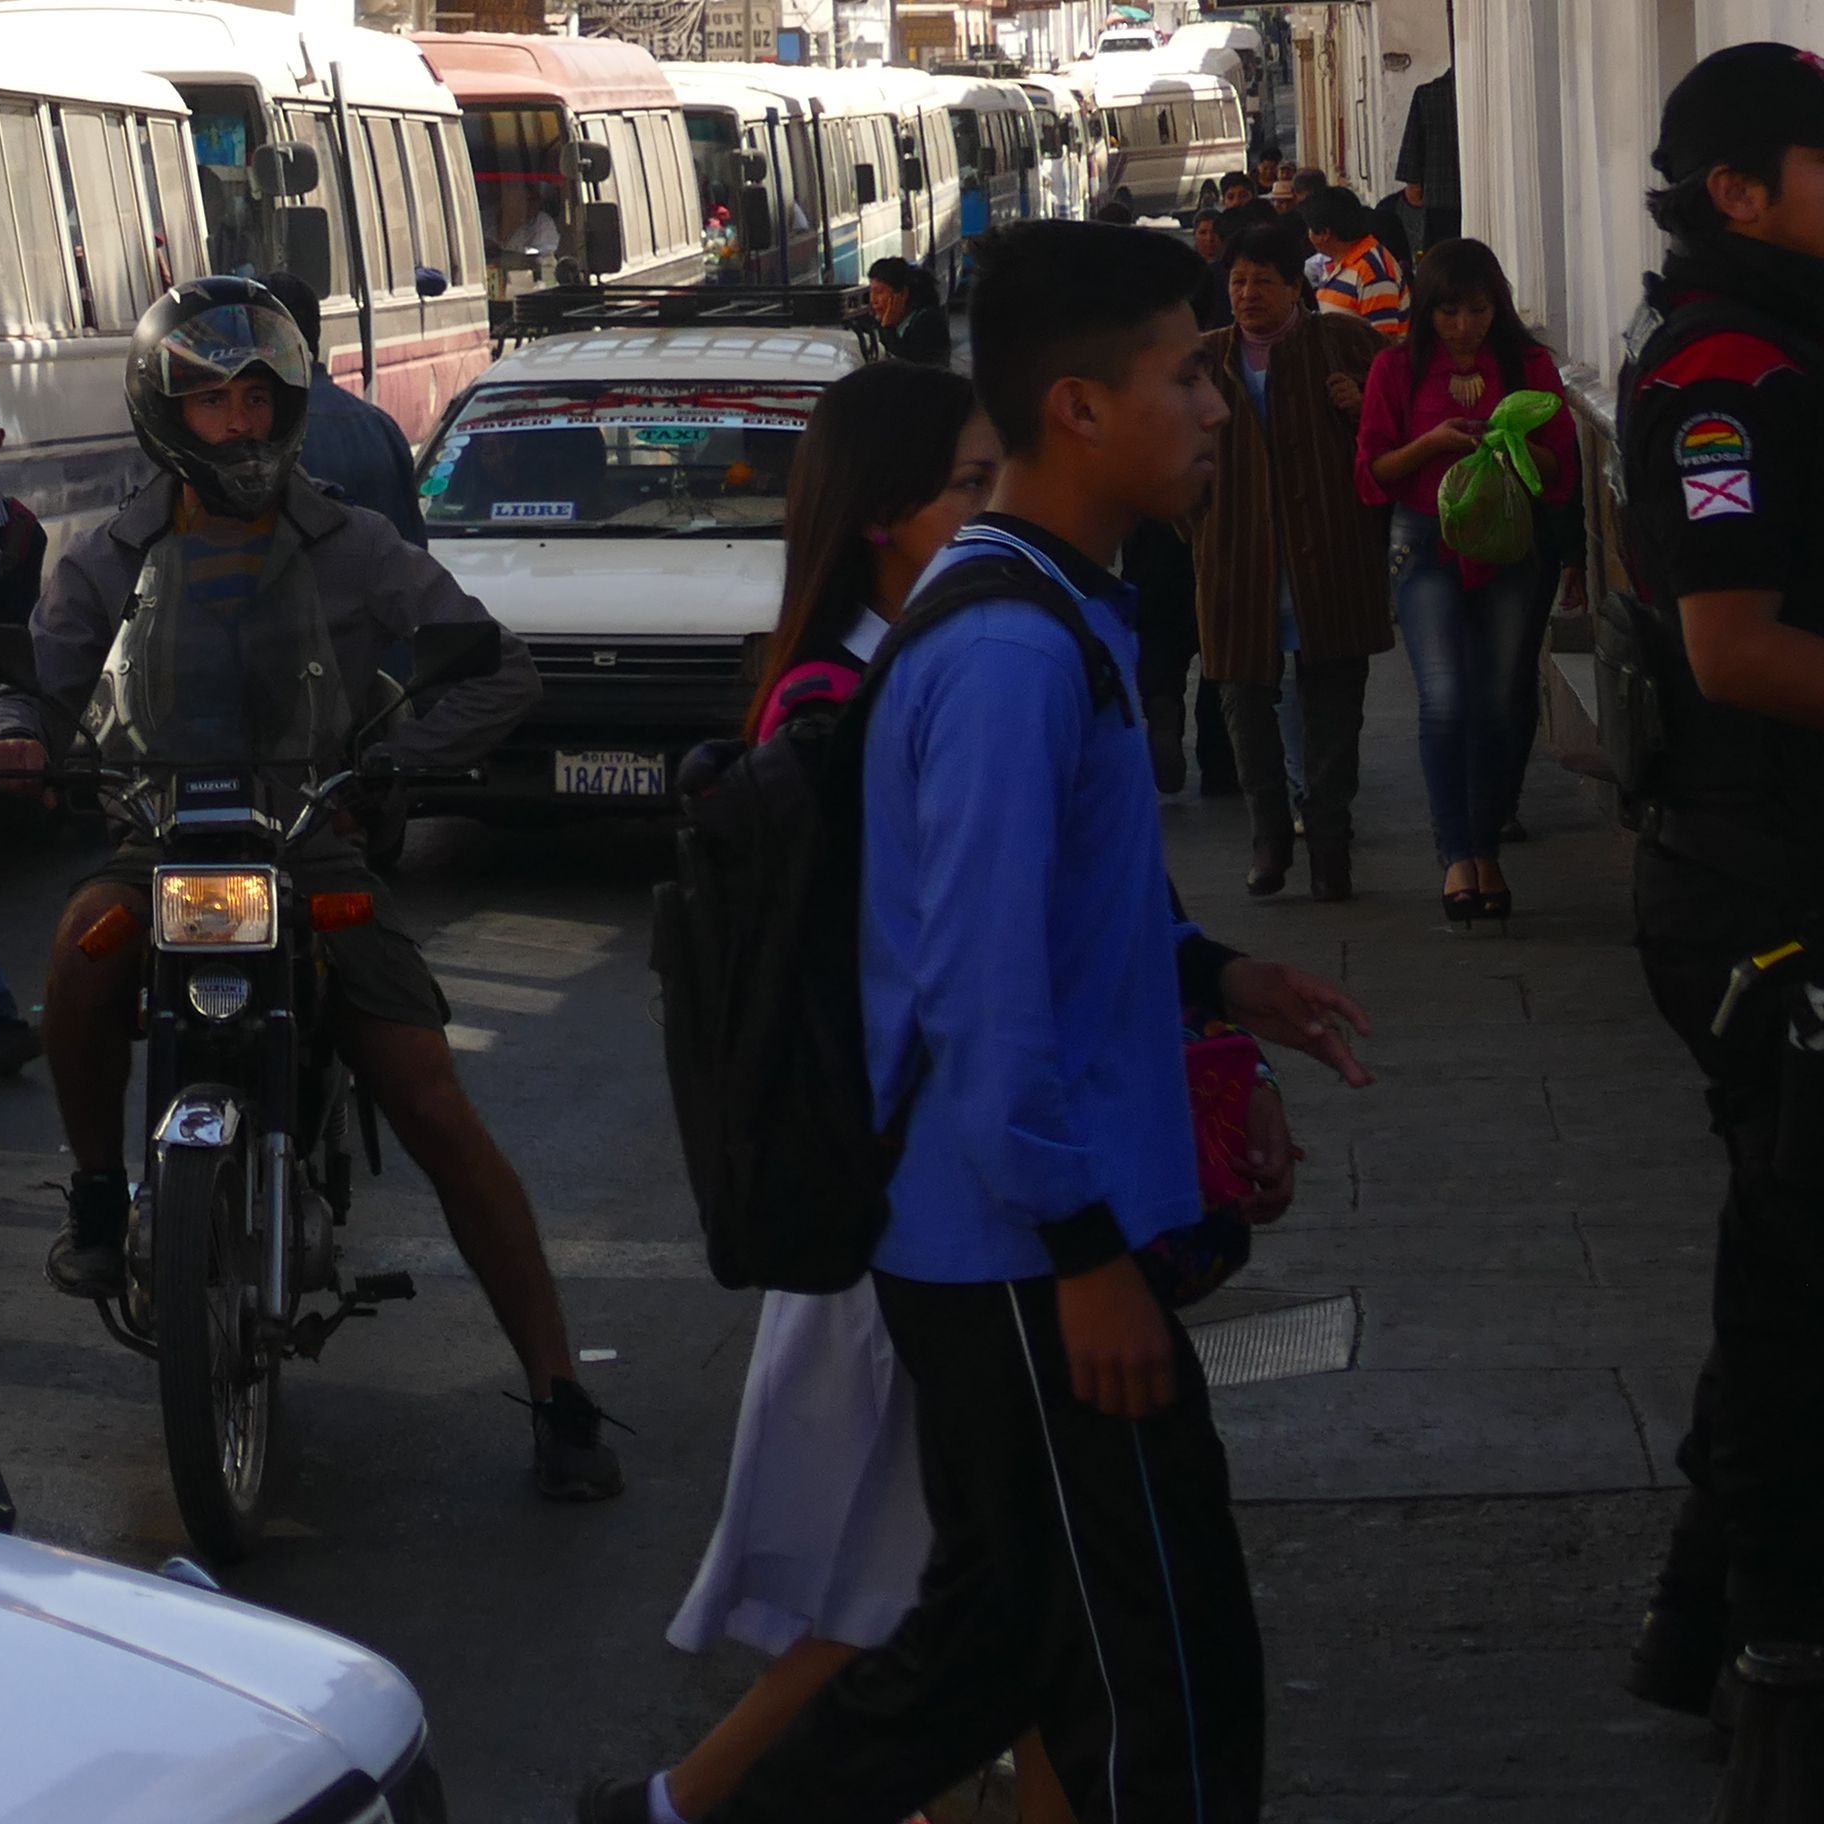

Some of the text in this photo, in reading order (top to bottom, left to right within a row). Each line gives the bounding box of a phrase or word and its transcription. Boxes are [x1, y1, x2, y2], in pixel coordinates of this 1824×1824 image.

[707, 30, 771, 48] ERACUZ
[454, 418, 552, 432] SERVICIO
[643, 428, 701, 441] TAXI
[494, 504, 572, 518] LIBRE
[581, 751, 640, 764] BOLIVIA
[190, 780, 239, 792] SUZUKI
[195, 982, 244, 994] SUZUKI
